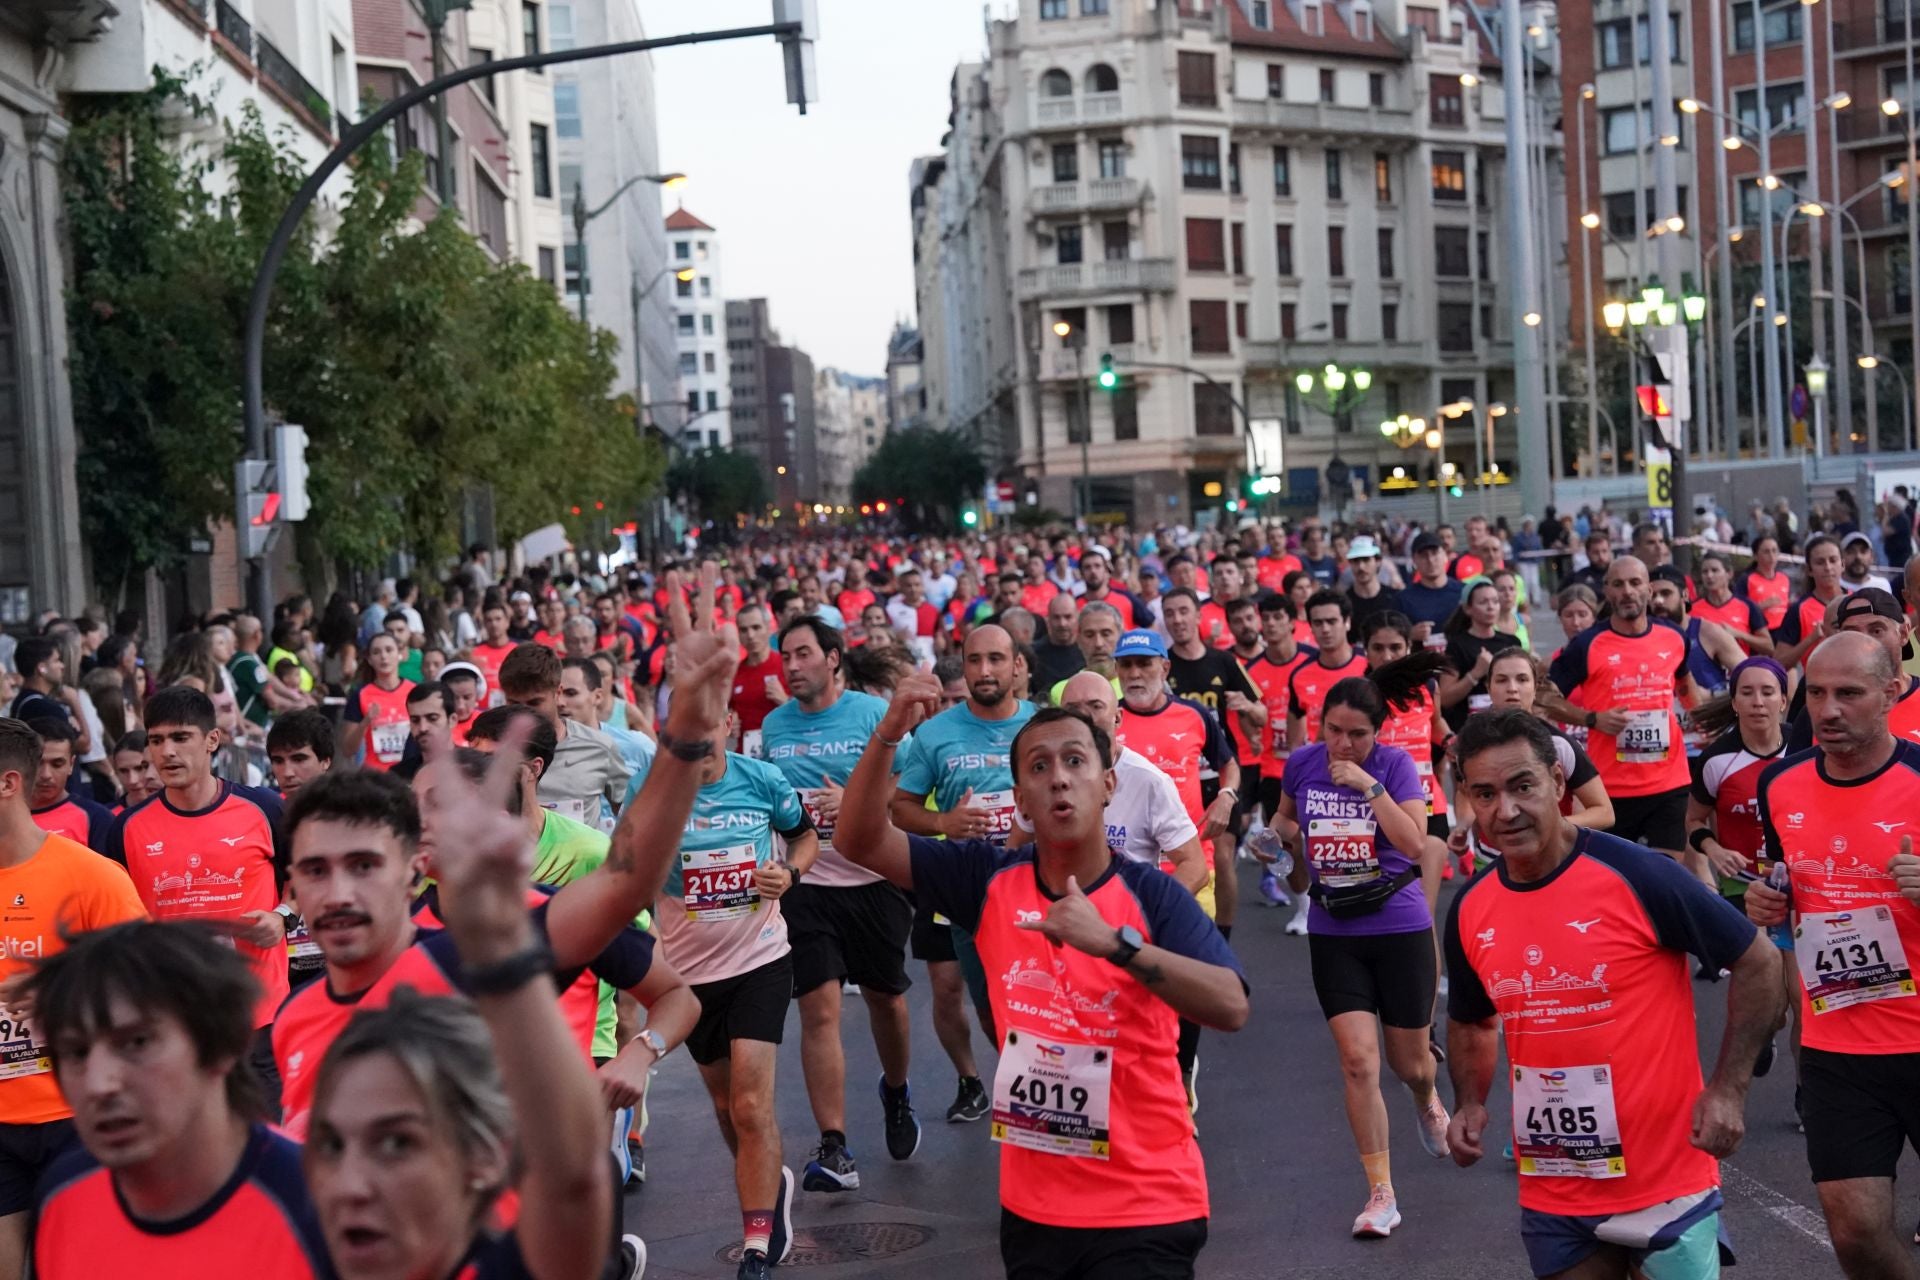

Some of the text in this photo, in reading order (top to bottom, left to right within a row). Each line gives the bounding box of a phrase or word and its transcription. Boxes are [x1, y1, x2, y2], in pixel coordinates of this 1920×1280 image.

[1658, 468, 1671, 502] 8
[1121, 635, 1150, 647] HOKA
[1625, 728, 1660, 742] 3381
[1307, 788, 1339, 801] 10KM
[1305, 799, 1358, 818] PARIS
[1313, 842, 1372, 861] 22438
[688, 868, 754, 895] 21437
[1826, 934, 1861, 946] LAURENT
[1815, 940, 1885, 972] 4131
[1520, 1008, 1545, 1018] NIGHT
[1547, 1004, 1586, 1017] RUNNING
[1009, 1074, 1089, 1113] 4019
[1526, 1106, 1598, 1134] 4185
